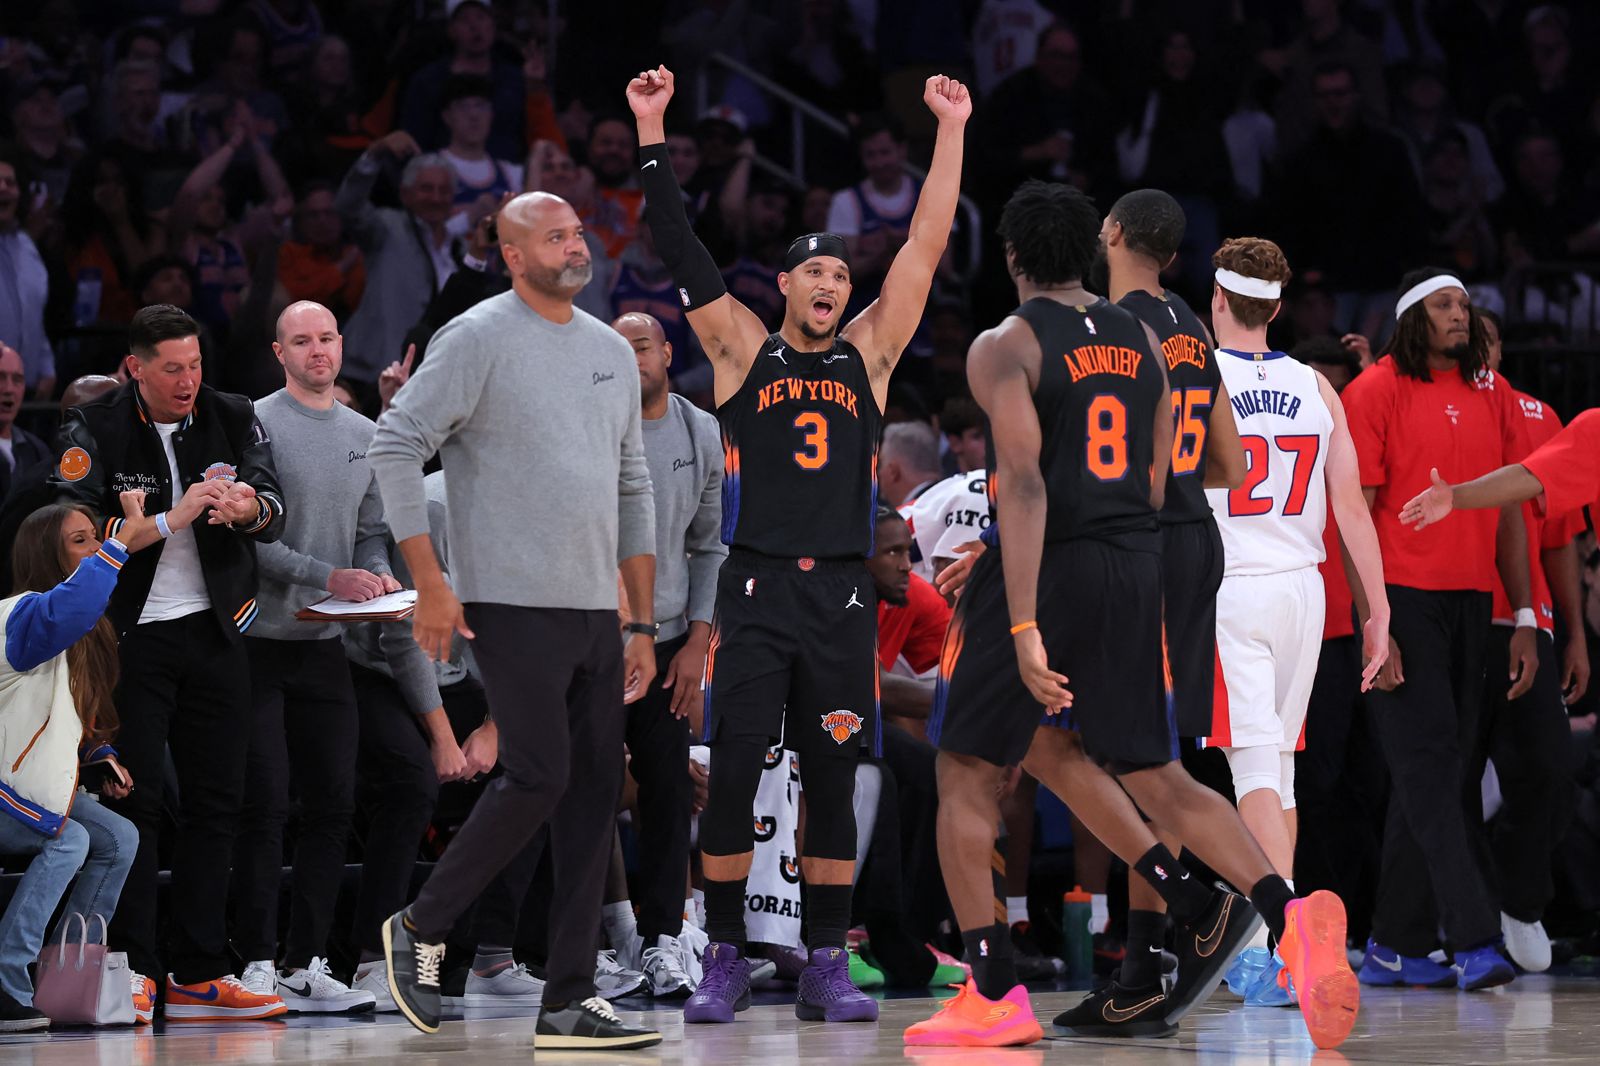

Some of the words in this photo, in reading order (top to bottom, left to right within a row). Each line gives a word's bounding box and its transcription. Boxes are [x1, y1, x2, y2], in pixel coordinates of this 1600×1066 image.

[1064, 345, 1142, 383] ANUNOBY
[1161, 334, 1207, 371] BRIDGES
[1231, 389, 1302, 420] HUERTER
[793, 411, 829, 471] 3
[1086, 392, 1129, 482] 8
[1171, 387, 1212, 477] 25
[112, 484, 123, 492] or
[123, 483, 160, 495] Nhere
[115, 472, 136, 482] New
[136, 473, 160, 487] York
[1228, 434, 1320, 517] 27
[746, 894, 801, 919] ORAD
